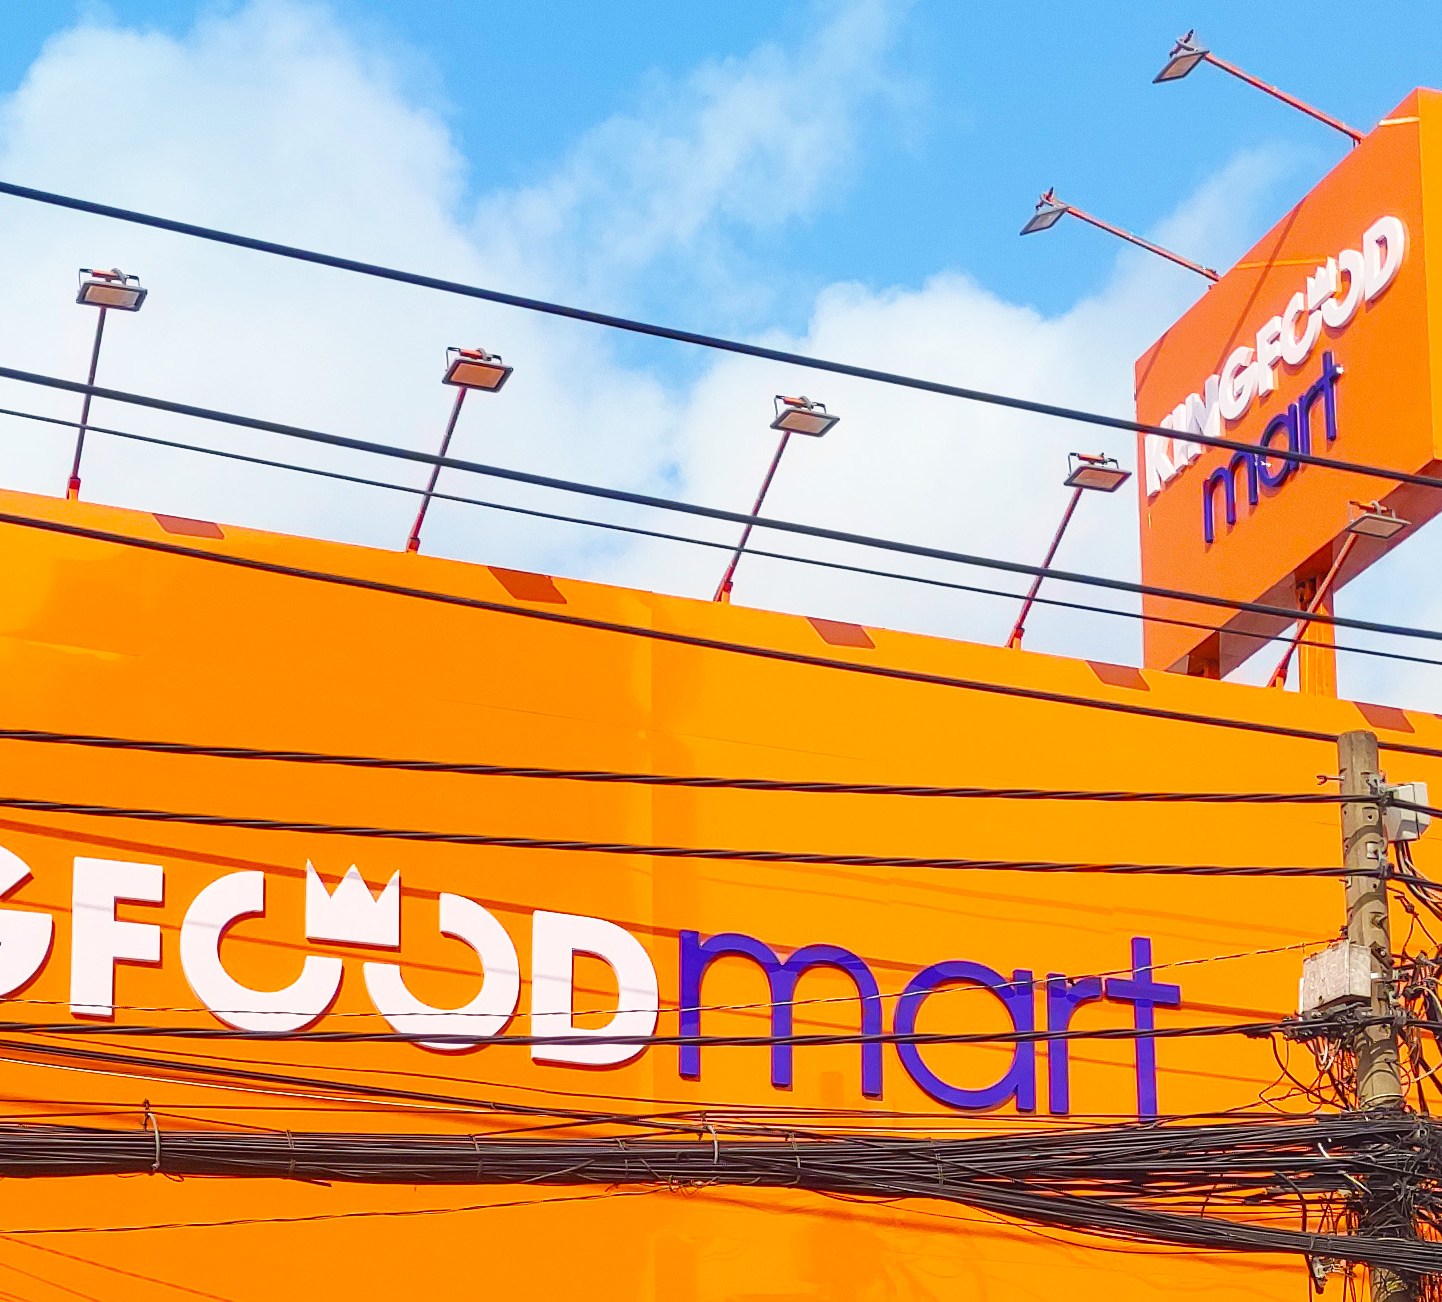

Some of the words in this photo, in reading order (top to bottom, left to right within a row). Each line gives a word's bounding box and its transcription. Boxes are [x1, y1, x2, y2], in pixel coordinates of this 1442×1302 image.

[1145, 215, 1408, 497] KINGFOOD
[1202, 350, 1344, 544] mart
[678, 930, 1181, 1119] mart
